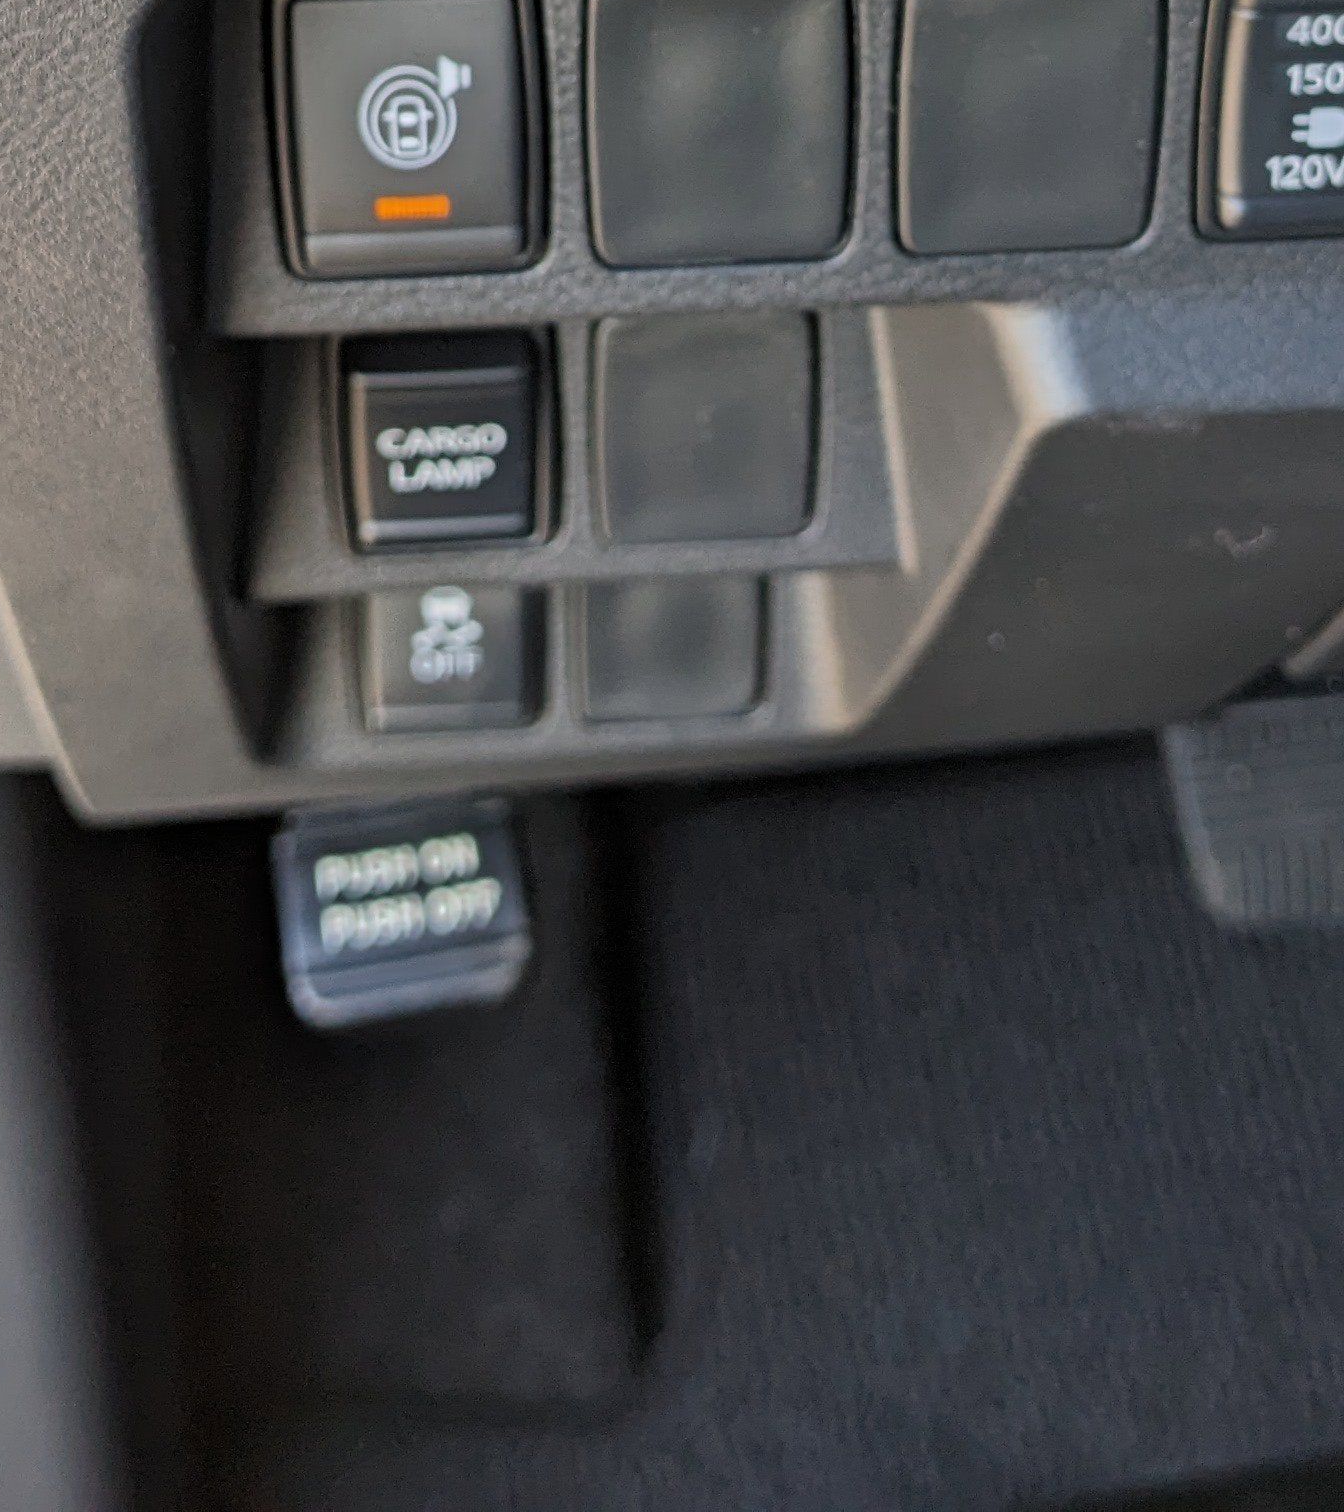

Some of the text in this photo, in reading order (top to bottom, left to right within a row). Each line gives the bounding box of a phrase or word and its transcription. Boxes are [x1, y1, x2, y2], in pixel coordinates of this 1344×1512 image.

[376, 422, 508, 461] CARGO
[388, 455, 497, 493] LAMP
[314, 843, 419, 903] PUSH
[320, 891, 425, 956] PUSH
